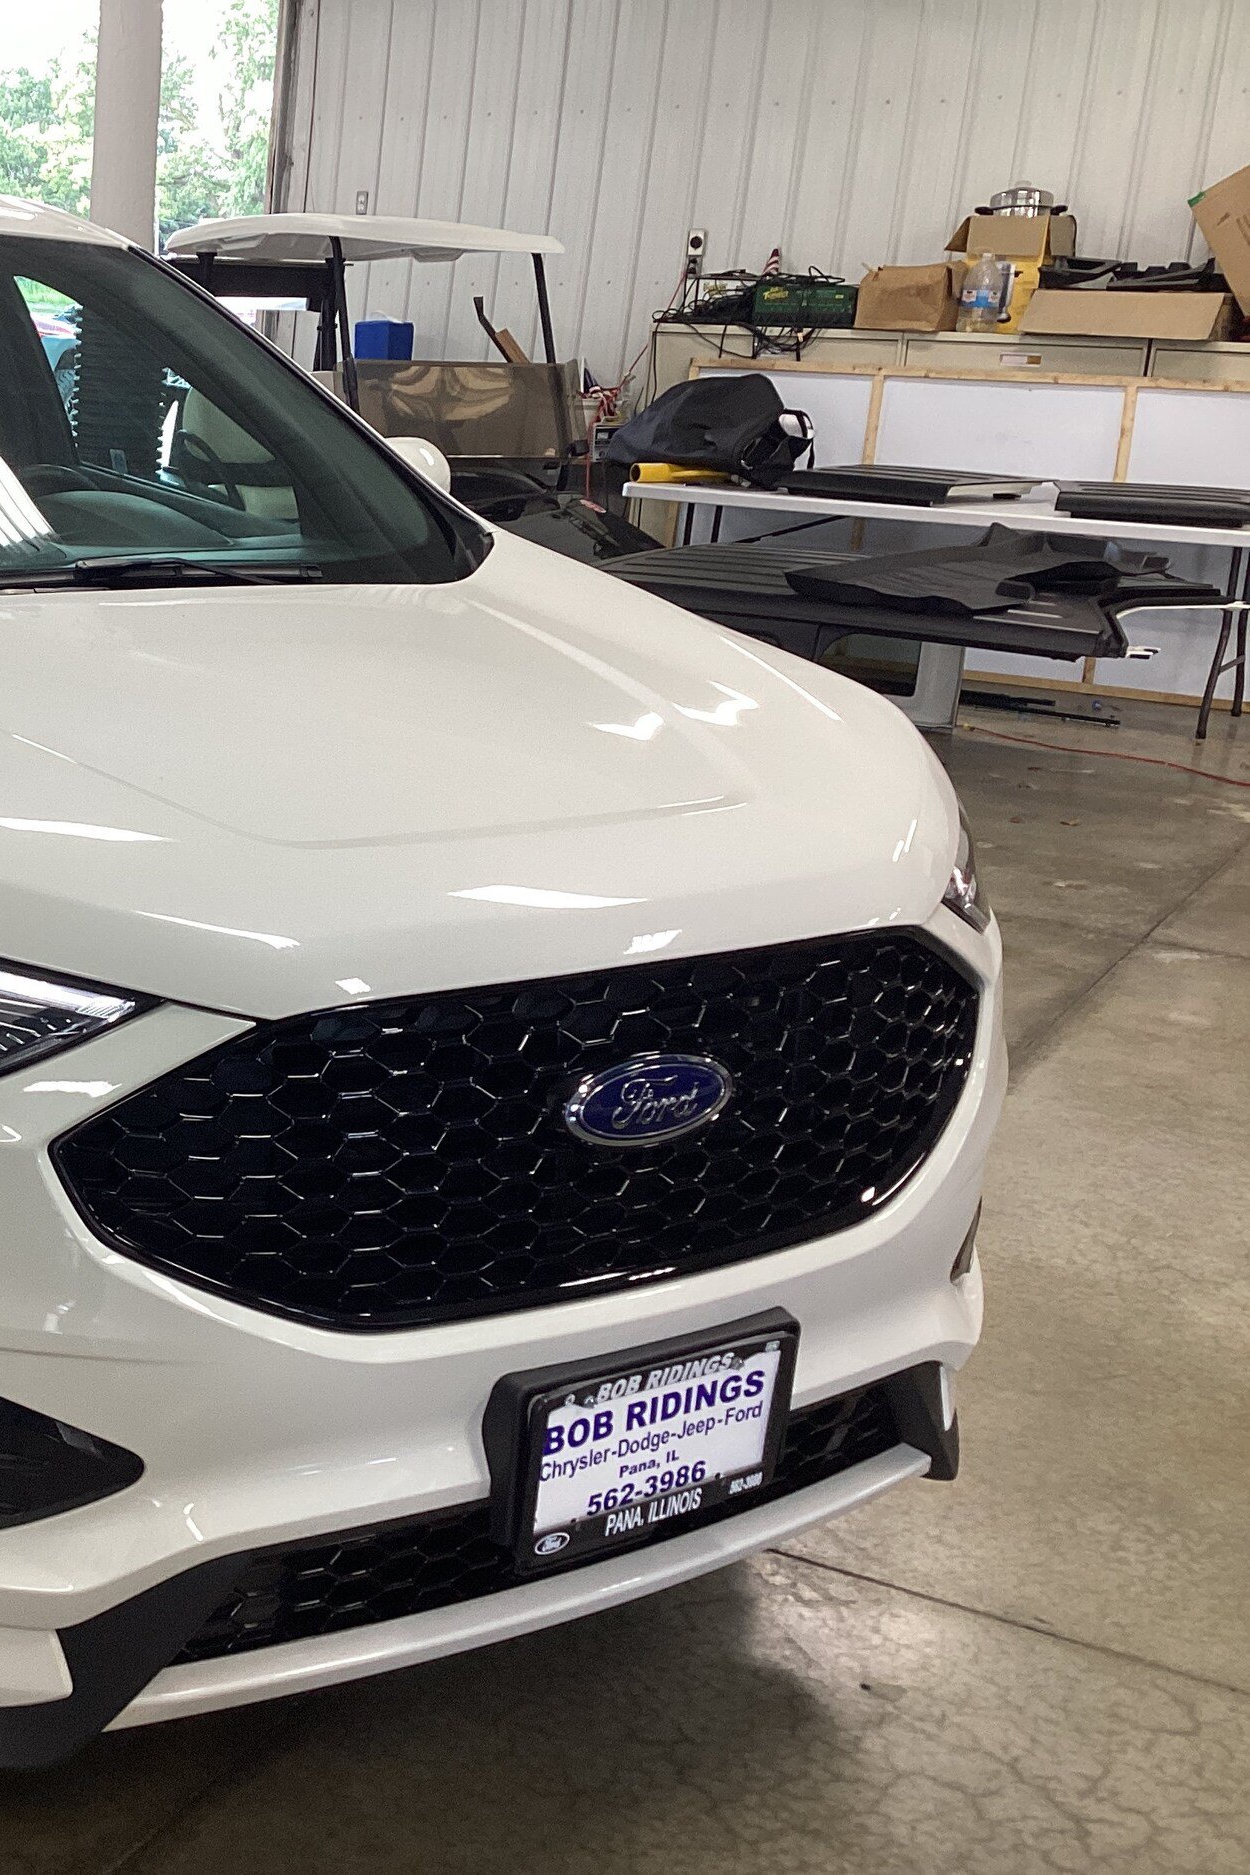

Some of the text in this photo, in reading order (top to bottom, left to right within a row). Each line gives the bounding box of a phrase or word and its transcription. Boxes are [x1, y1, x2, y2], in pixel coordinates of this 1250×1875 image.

[612, 1075, 699, 1129] Ford
[597, 1352, 735, 1402] BOB RIDINGS
[542, 1370, 765, 1456] BOB RIDINGS
[539, 1400, 763, 1482] Chrysler-Dodge-Jeep-Ford
[619, 1450, 679, 1478] Pana, IL
[587, 1460, 706, 1516] 562-3986
[648, 1487, 702, 1523] ILLINOIS
